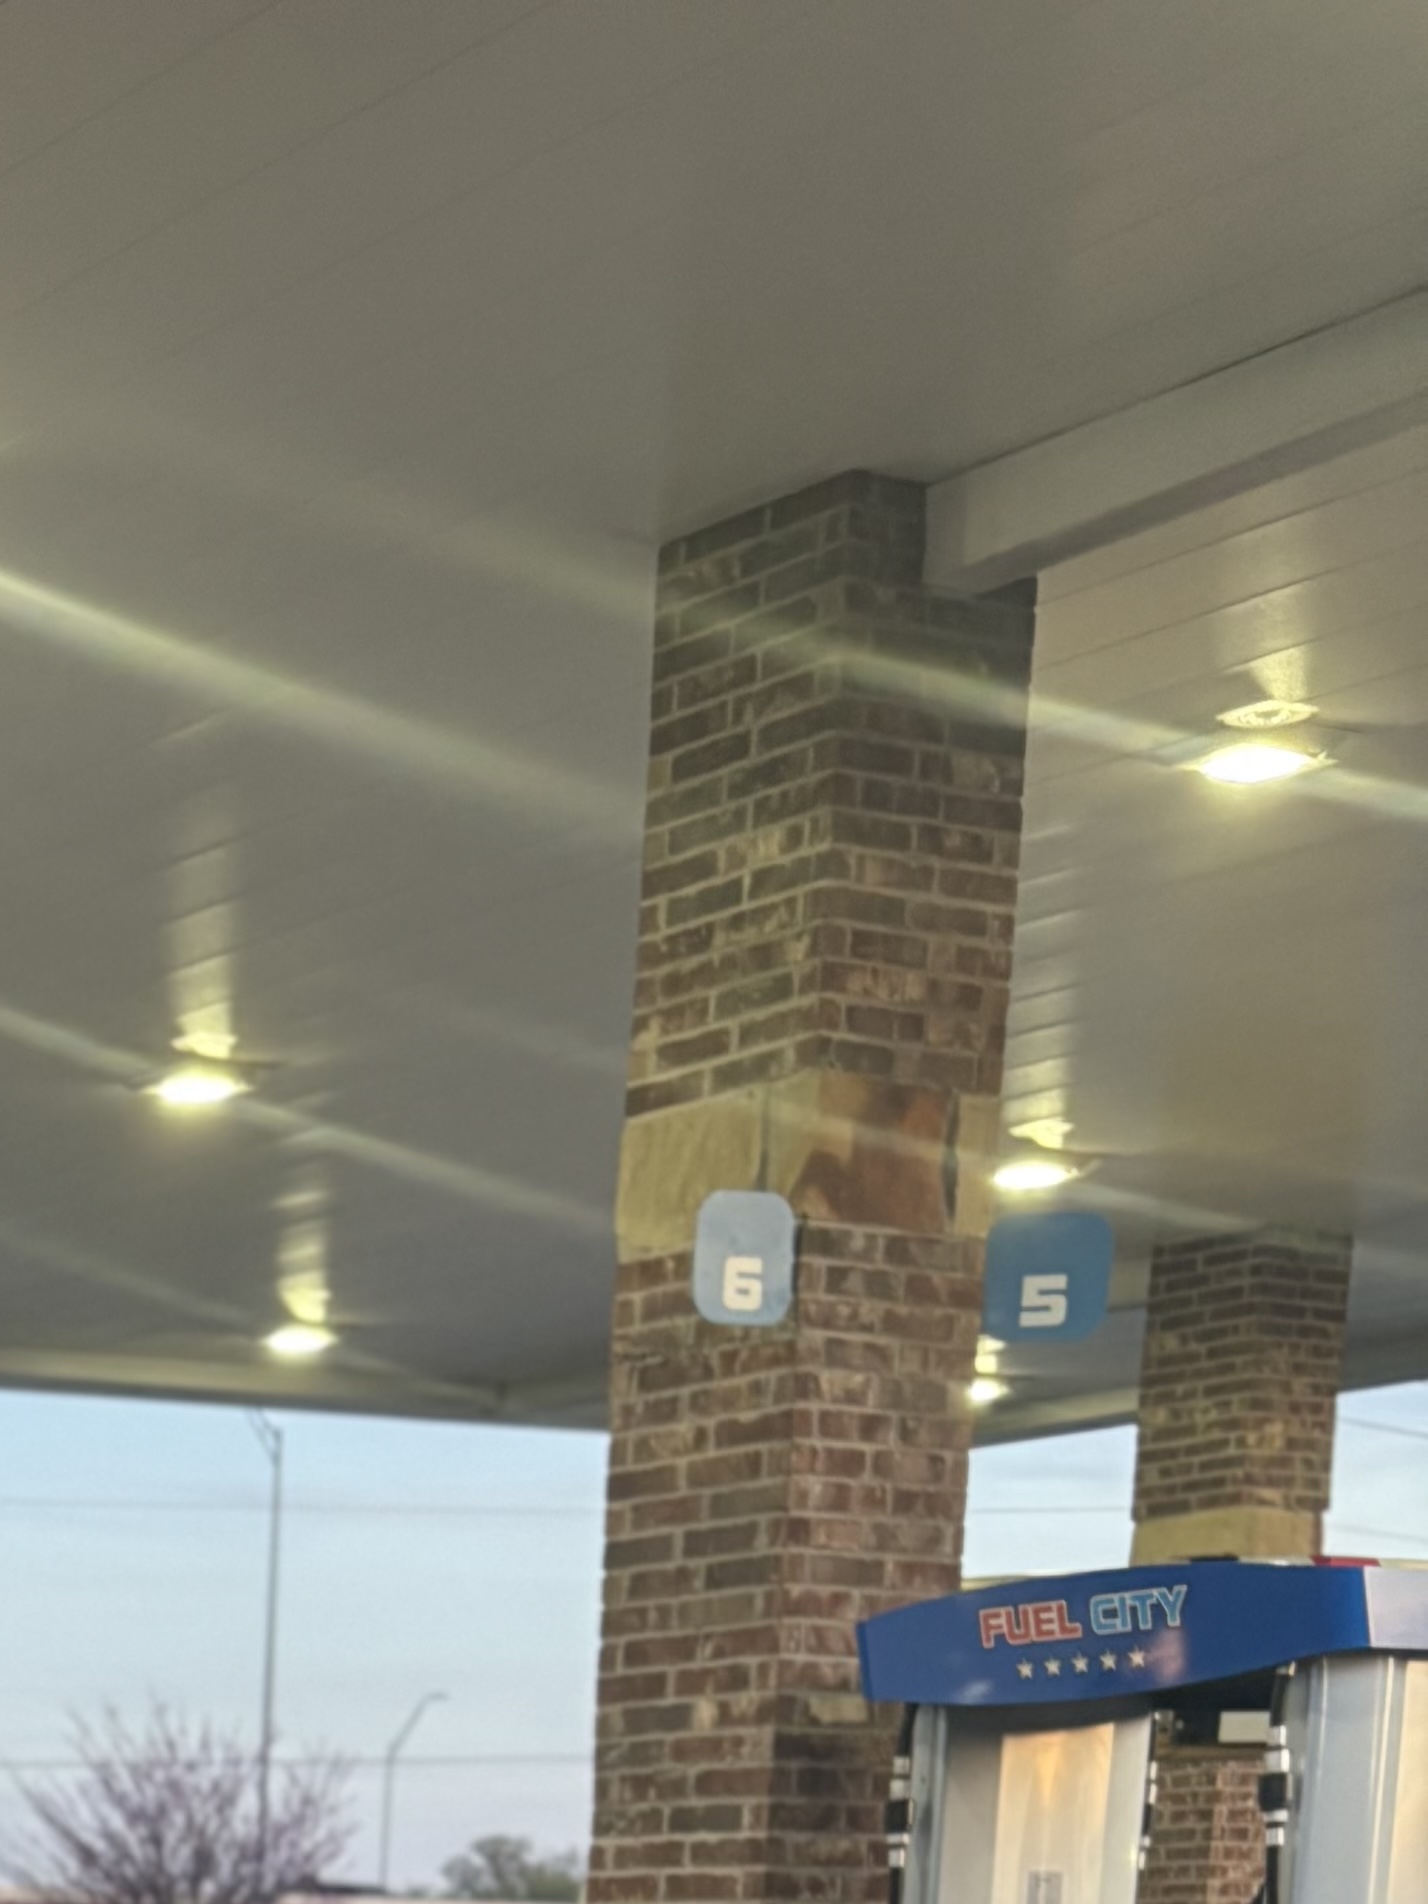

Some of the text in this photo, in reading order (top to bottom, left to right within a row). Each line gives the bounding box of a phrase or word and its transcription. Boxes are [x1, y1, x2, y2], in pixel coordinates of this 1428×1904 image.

[722, 1255, 763, 1311] 6
[1018, 1274, 1068, 1328] 5
[978, 1584, 1188, 1649] FUEL CITY
